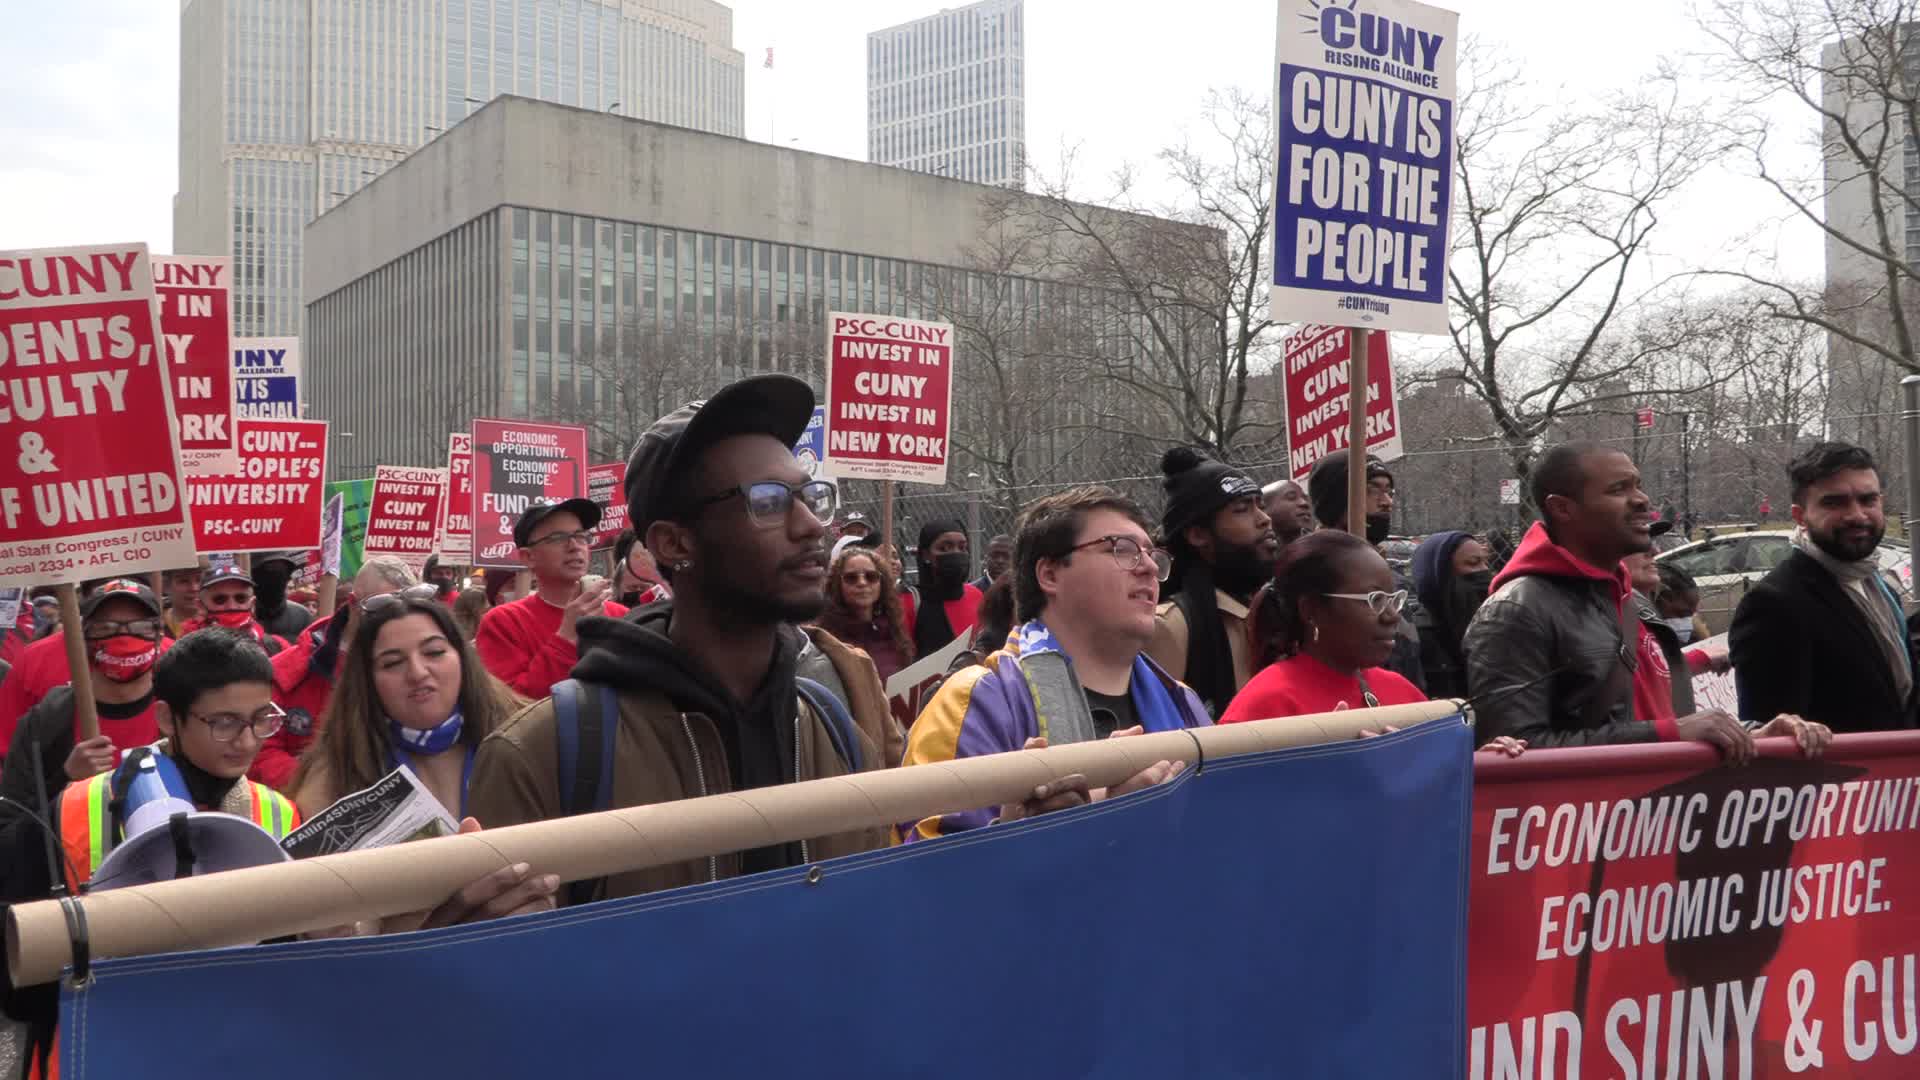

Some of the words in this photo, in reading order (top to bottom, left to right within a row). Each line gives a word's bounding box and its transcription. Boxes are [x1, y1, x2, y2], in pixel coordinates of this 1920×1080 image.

[1321, 7, 1444, 73] CUNY
[1325, 49, 1381, 72] RISING
[1383, 61, 1439, 89] ALLIANCE
[1292, 71, 1401, 148] CUNY
[1406, 95, 1442, 159] IS
[1289, 143, 1371, 213] FOR
[1379, 157, 1440, 226] THE
[1295, 217, 1429, 292] PEOPLE
[152, 262, 224, 287] UNY
[178, 294, 212, 317] IN
[1337, 295, 1390, 315] #CUNYrising
[835, 318, 948, 344] PSC-CUNY
[235, 349, 287, 367] NY
[841, 341, 912, 363] INVEST
[918, 347, 940, 366] IN
[1289, 328, 1346, 376] INVEST
[178, 376, 212, 399] IN
[251, 379, 269, 399] IS
[854, 372, 928, 399] CUNY
[1303, 359, 1350, 403] CUN
[840, 402, 910, 423] INVEST
[915, 408, 936, 426] IN
[1296, 391, 1349, 437] INVEST
[493, 442, 569, 459] OPPORTUNITY.
[502, 431, 558, 446] ECONOMIC
[831, 430, 880, 453] NEW
[886, 433, 944, 458] YORK
[18, 431, 60, 475] &
[1292, 434, 1329, 473] NEW
[378, 469, 442, 482] PSC-CUNY
[503, 459, 559, 474] ECONOMIC
[32, 471, 177, 527] UNITED
[379, 482, 420, 496] INVEST
[422, 485, 436, 497] IN
[384, 501, 427, 516] CUNY
[482, 493, 529, 514] FUND
[204, 518, 284, 535] PSC-CUNY
[374, 518, 415, 531] INVEST
[416, 520, 430, 532] IN
[447, 514, 471, 531] STA
[498, 515, 513, 535] &
[16, 544, 51, 558] Staff
[55, 534, 129, 555] Congress
[142, 528, 184, 543] CUNY
[367, 535, 397, 549] NEW
[400, 536, 433, 550] YORK
[39, 558, 74, 572] 2334
[89, 553, 120, 566] AFL
[123, 548, 151, 561] CIO
[1487, 792, 1709, 875] ECONOMIC
[1536, 872, 1744, 961] ECONOMIC
[1750, 858, 1891, 931] JUSTICE.
[1605, 976, 1768, 1080] SUNY
[1784, 968, 1824, 1073] &
[1843, 954, 1918, 1061] CU
